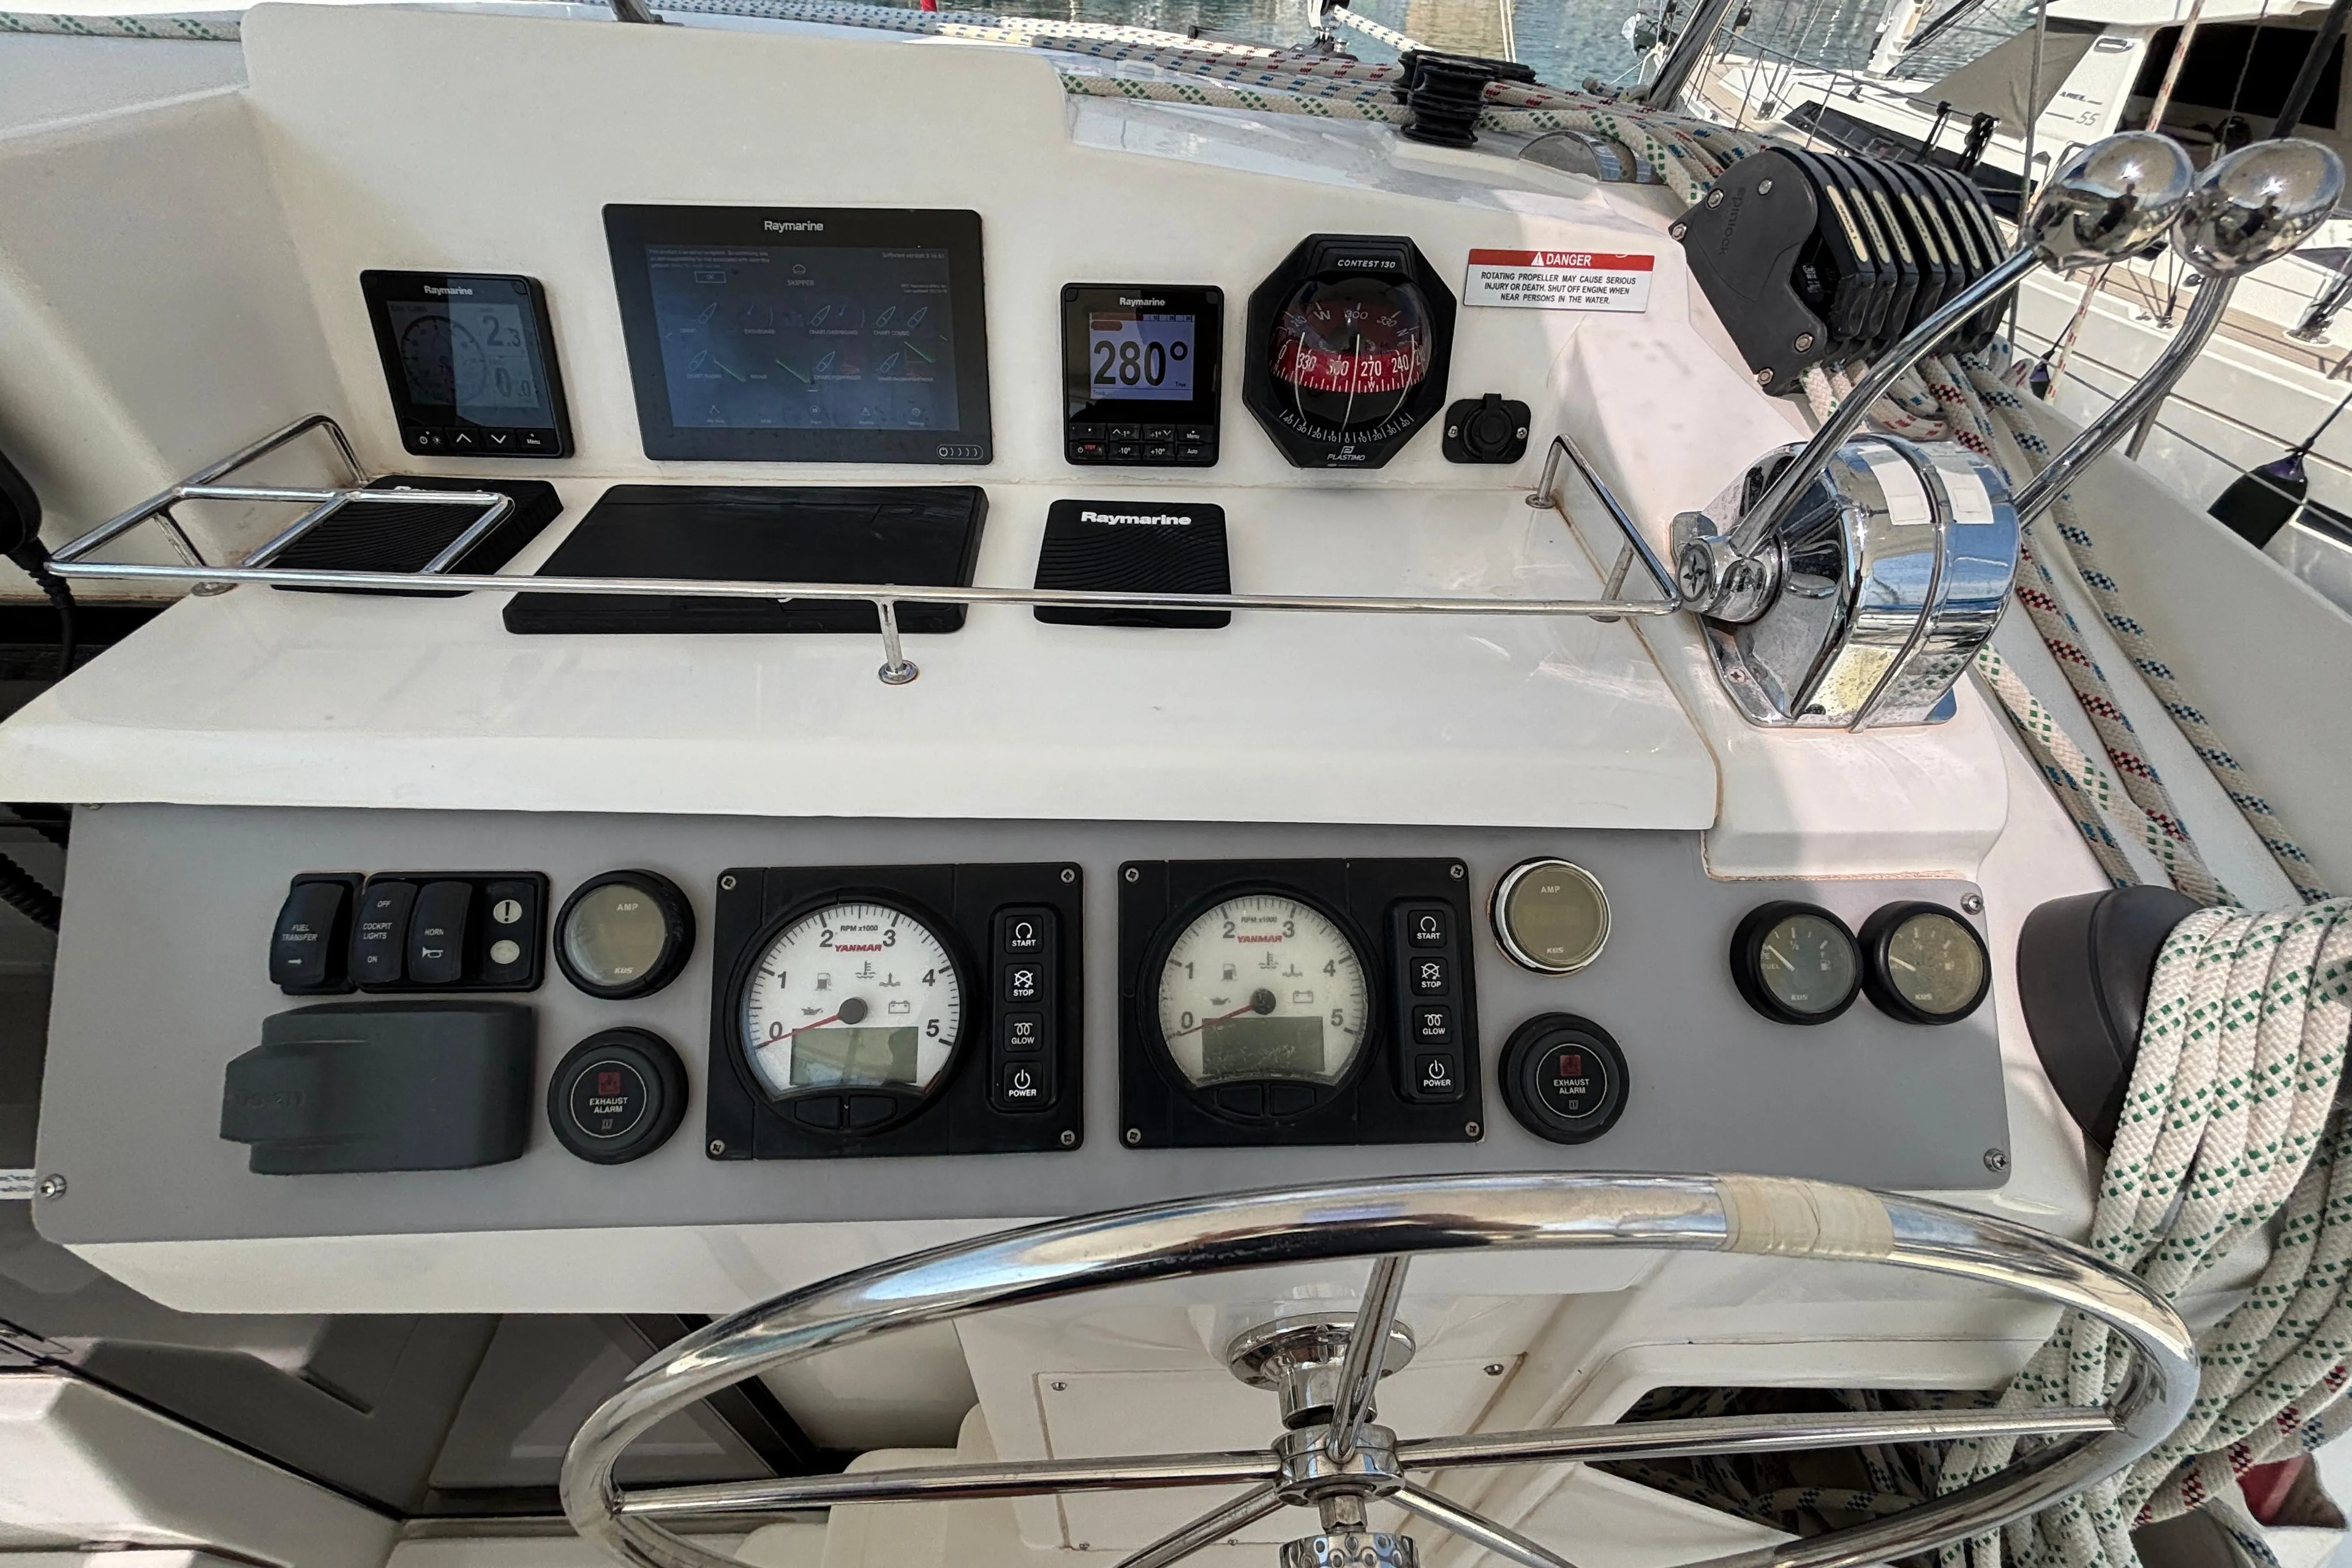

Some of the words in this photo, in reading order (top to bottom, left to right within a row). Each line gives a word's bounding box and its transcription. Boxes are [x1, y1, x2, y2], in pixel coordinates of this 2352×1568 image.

[2076, 111, 2101, 126] 55
[764, 221, 824, 232] Raymarine
[1337, 258, 1381, 268] CONTEST
[1381, 260, 1396, 269] 130
[1546, 253, 1593, 267] DANGER
[1481, 271, 1515, 281] ROTATING
[1518, 273, 1559, 282] PROPELLER
[1579, 276, 1603, 284] CAUSE
[1606, 276, 1637, 285] SERIOUS
[424, 285, 473, 295] Raymarine
[1484, 282, 1509, 291] INJURY
[1521, 284, 1546, 292] DEATH.
[1119, 297, 1165, 306] Raymarine
[1500, 293, 1520, 301] NEAR
[1523, 294, 1556, 303] PERSONS
[1558, 295, 1565, 303] IN
[1585, 296, 1610, 304] WATER.
[1093, 340, 1188, 387] 280°
[1297, 352, 1317, 372] 330
[1361, 360, 1382, 377] 270
[1391, 353, 1410, 374] 240
[1283, 416, 1293, 424] 40
[1401, 419, 1411, 428] 40
[1297, 424, 1306, 434] 30
[1387, 427, 1397, 436] 30
[1081, 511, 1192, 526] Raymarine
[616, 903, 639, 912] AMP
[363, 932, 388, 940] LIGHTS
[1223, 921, 1235, 939] 2
[1283, 921, 1295, 938] 3
[820, 930, 834, 948] 2
[883, 929, 896, 948] 3
[1237, 935, 1283, 943] YANMAR
[834, 944, 882, 952] YANMAR
[368, 955, 378, 963] ON
[1185, 962, 1194, 979] 1
[1323, 959, 1336, 977] 4
[777, 971, 787, 989] 1
[922, 969, 935, 987] 4
[1181, 1011, 1194, 1030] 0
[1331, 1009, 1343, 1027] 5
[769, 1021, 783, 1041] 0
[926, 1019, 940, 1038] 5
[1553, 1079, 1590, 1087] EXHAUST
[589, 1096, 629, 1106] EXHAUST
[594, 1105, 624, 1114] ALARM
